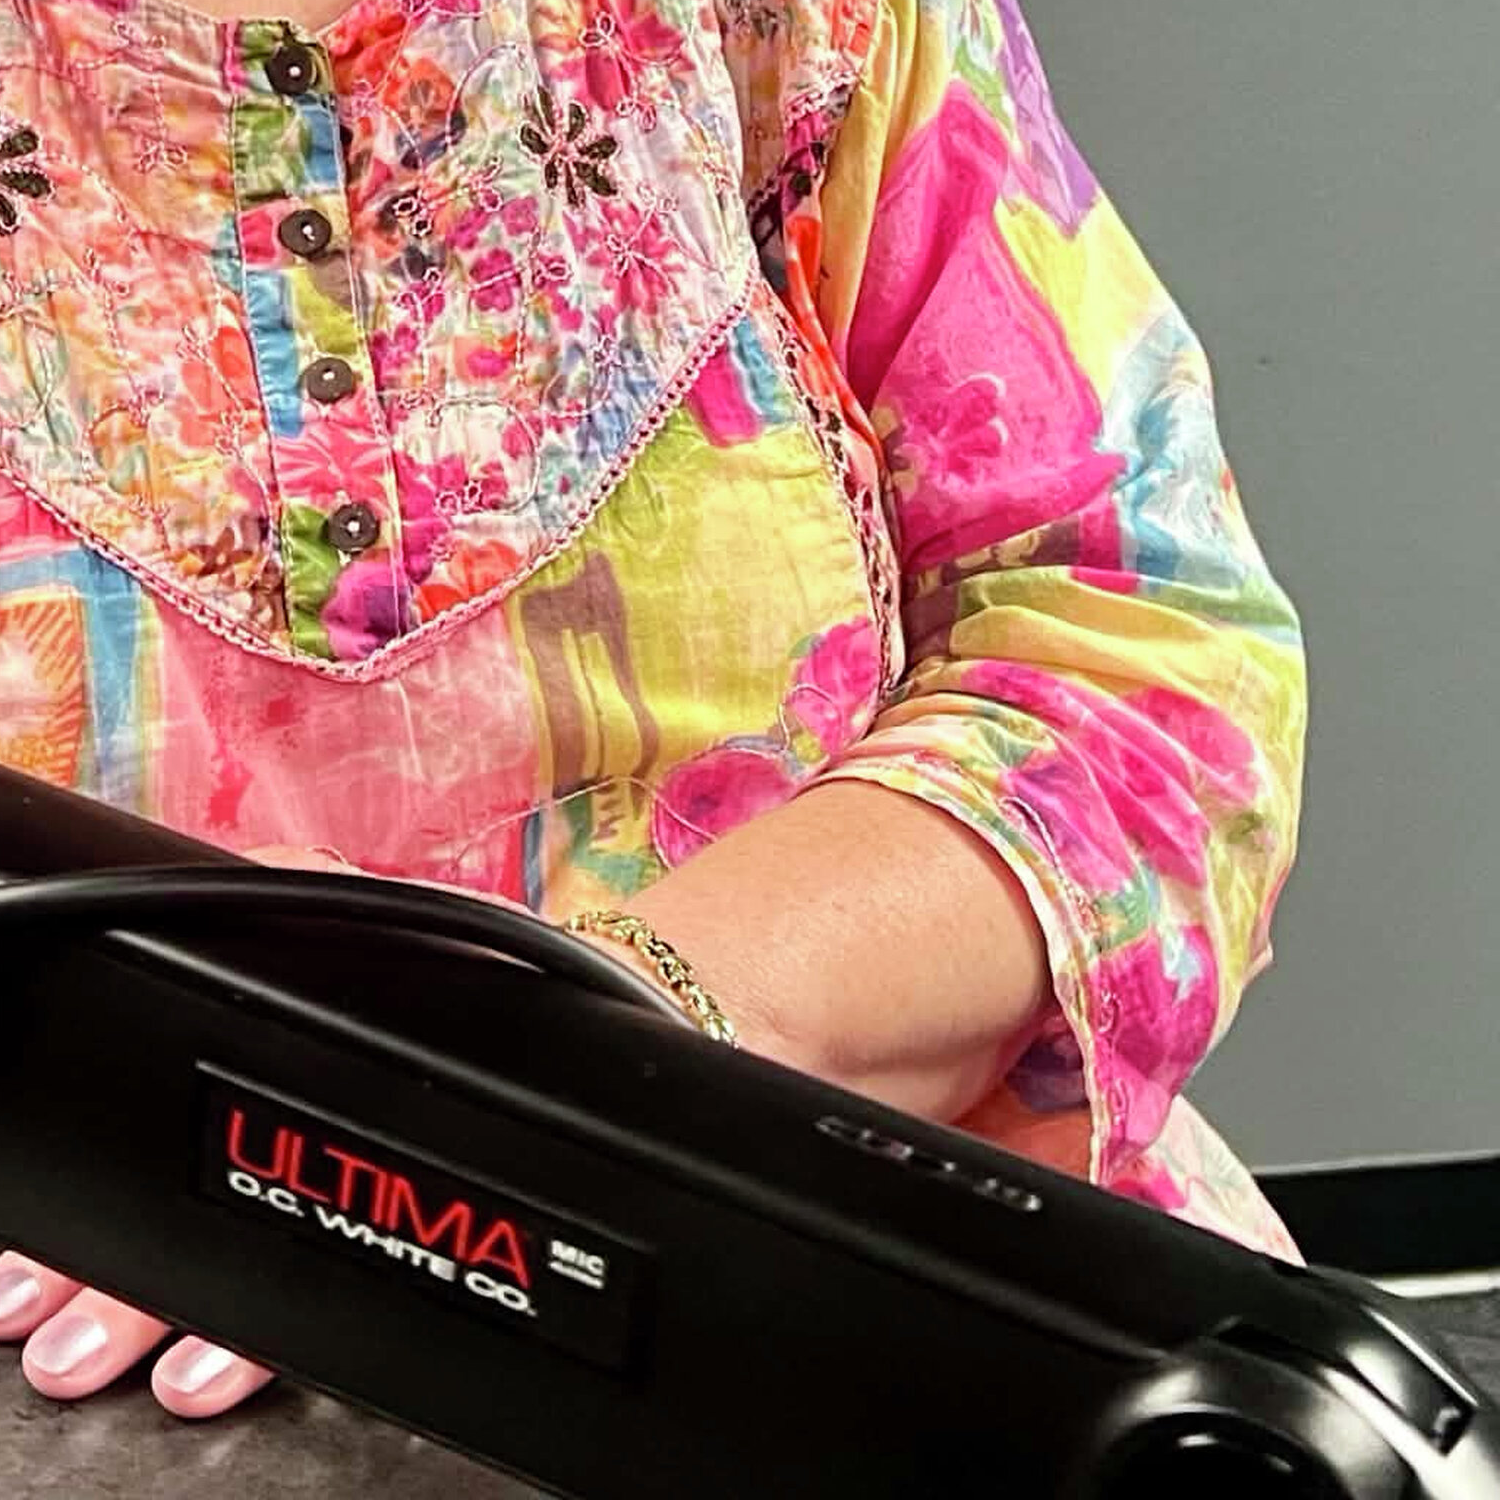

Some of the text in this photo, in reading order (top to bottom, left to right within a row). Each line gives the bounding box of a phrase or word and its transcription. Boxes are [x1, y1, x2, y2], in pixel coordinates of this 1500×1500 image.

[225, 1107, 531, 1290] ULTIMA
[314, 1203, 457, 1283] WHITE
[463, 1270, 538, 1318] CO.
[550, 1239, 605, 1277] MIC
